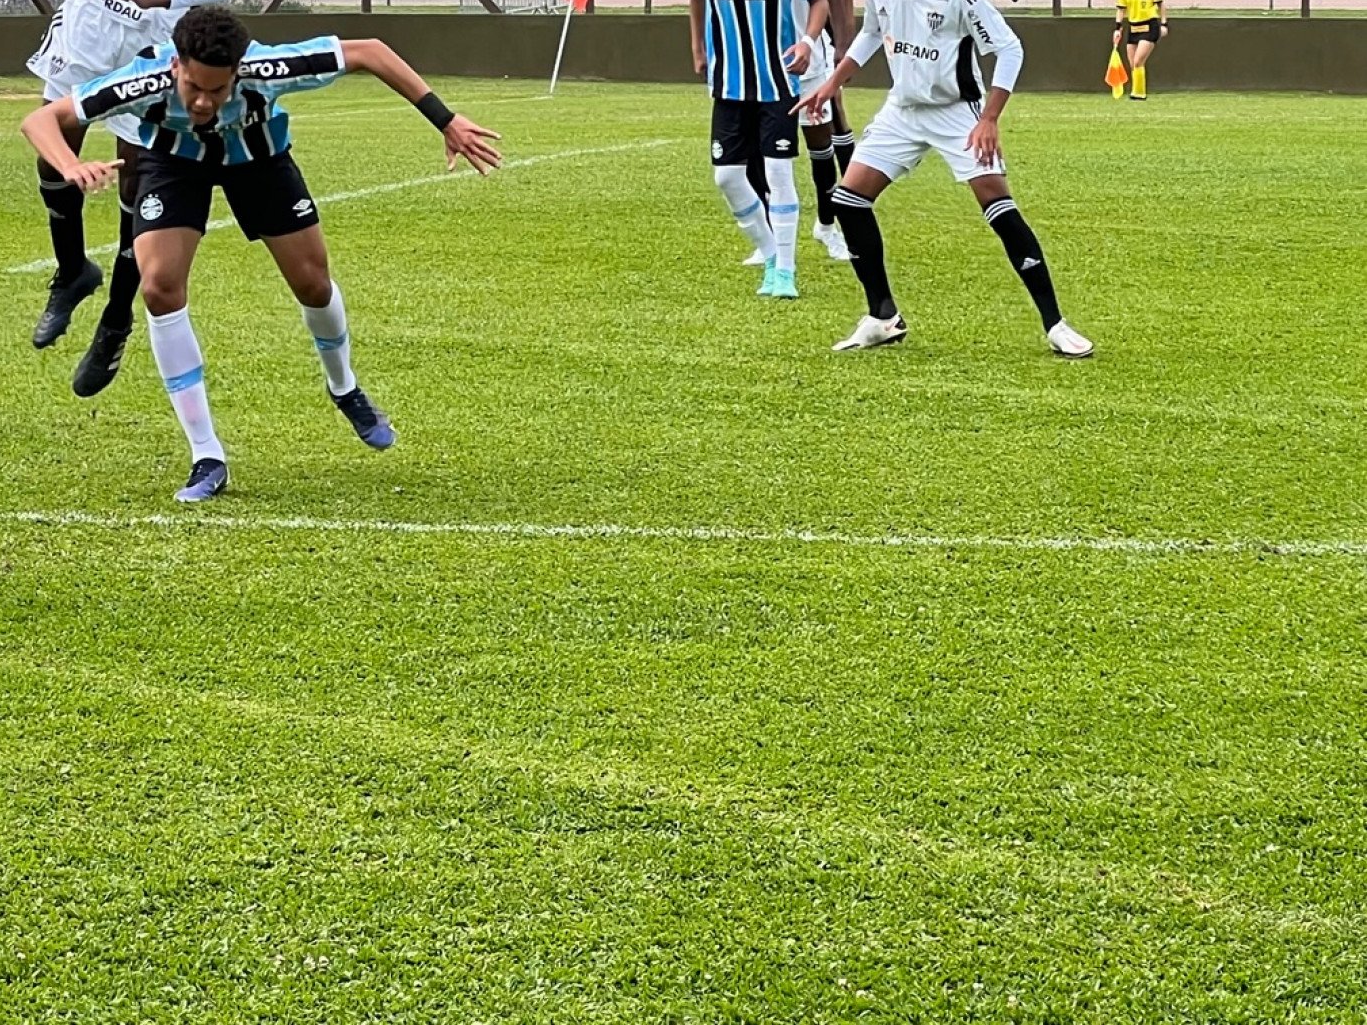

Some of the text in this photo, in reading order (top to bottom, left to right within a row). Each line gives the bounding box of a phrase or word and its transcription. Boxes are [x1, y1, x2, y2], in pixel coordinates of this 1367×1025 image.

[973, 20, 994, 45] MRV
[893, 41, 940, 61] BETANO
[237, 61, 274, 78] ero
[113, 76, 159, 100] vero
